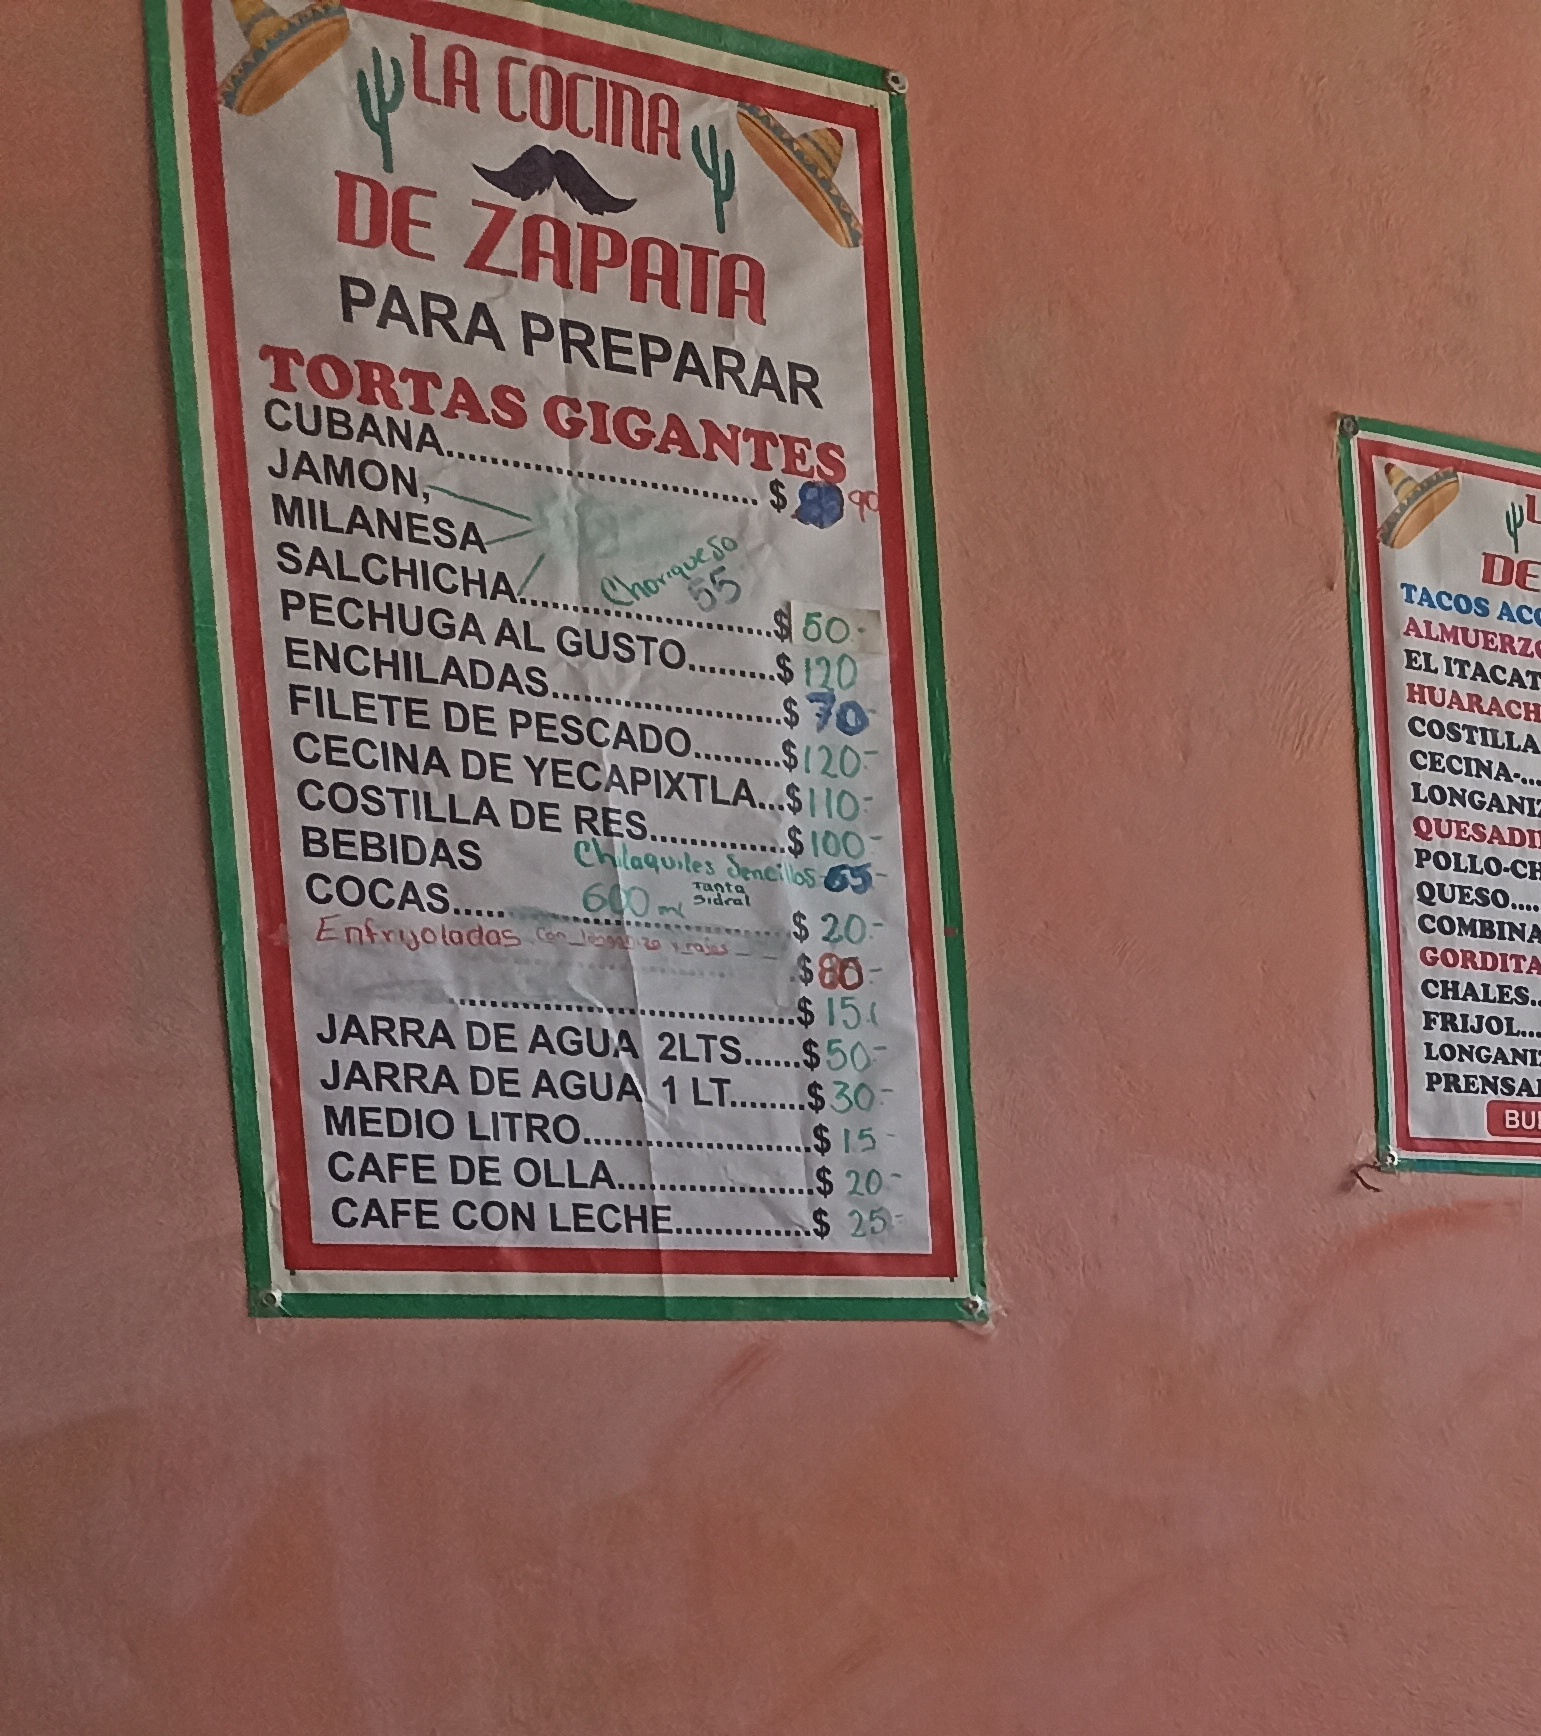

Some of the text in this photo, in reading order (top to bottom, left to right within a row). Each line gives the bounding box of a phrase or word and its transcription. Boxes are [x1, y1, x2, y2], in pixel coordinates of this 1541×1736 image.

[410, 34, 681, 161] LA COCINA
[335, 169, 767, 325] DE ZAPATA
[339, 275, 823, 408] PARA PREPARAR
[259, 344, 847, 484] TORTAS GIGANTES
[268, 448, 430, 504] JAMON,
[272, 493, 487, 553] MILANESA
[1401, 583, 1490, 618] TACOS
[281, 589, 486, 645] PECHUGA
[494, 617, 545, 653] AL
[557, 625, 686, 669] GUSTO
[284, 637, 549, 698] ENCHILADAS
[1405, 649, 1441, 675] EL
[289, 683, 430, 729] FILETE
[443, 701, 497, 737] DE
[510, 709, 692, 756] PESCADO
[1408, 715, 1541, 755] COSTILLA
[293, 732, 450, 777] CECINA
[461, 749, 513, 783] DE
[297, 779, 500, 827] COSTILLA
[510, 799, 562, 833] DE
[574, 805, 647, 840] RES
[302, 826, 483, 871] BEBIDAS
[306, 873, 450, 914] COCAS
[1417, 881, 1510, 910] QUESO
[1420, 979, 1529, 1007] CHALES
[316, 1013, 455, 1049] JARRA
[466, 1021, 517, 1053] DE
[528, 1024, 639, 1059] AGUA
[658, 1031, 742, 1064] 2LTS
[1422, 1011, 1522, 1038] FRIJOL
[320, 1059, 459, 1095] JARRA
[469, 1066, 521, 1097] DE
[531, 1069, 644, 1102] AGUA
[662, 1075, 676, 1105] 1
[324, 1105, 454, 1140] MEDIO
[468, 1111, 580, 1144] LITRO
[328, 1151, 437, 1184] CAFE
[449, 1155, 502, 1186] DE
[513, 1157, 616, 1189] OLLA
[331, 1197, 440, 1229] CAFE
[452, 1200, 535, 1231] CON
[550, 1203, 672, 1234] LECHE
